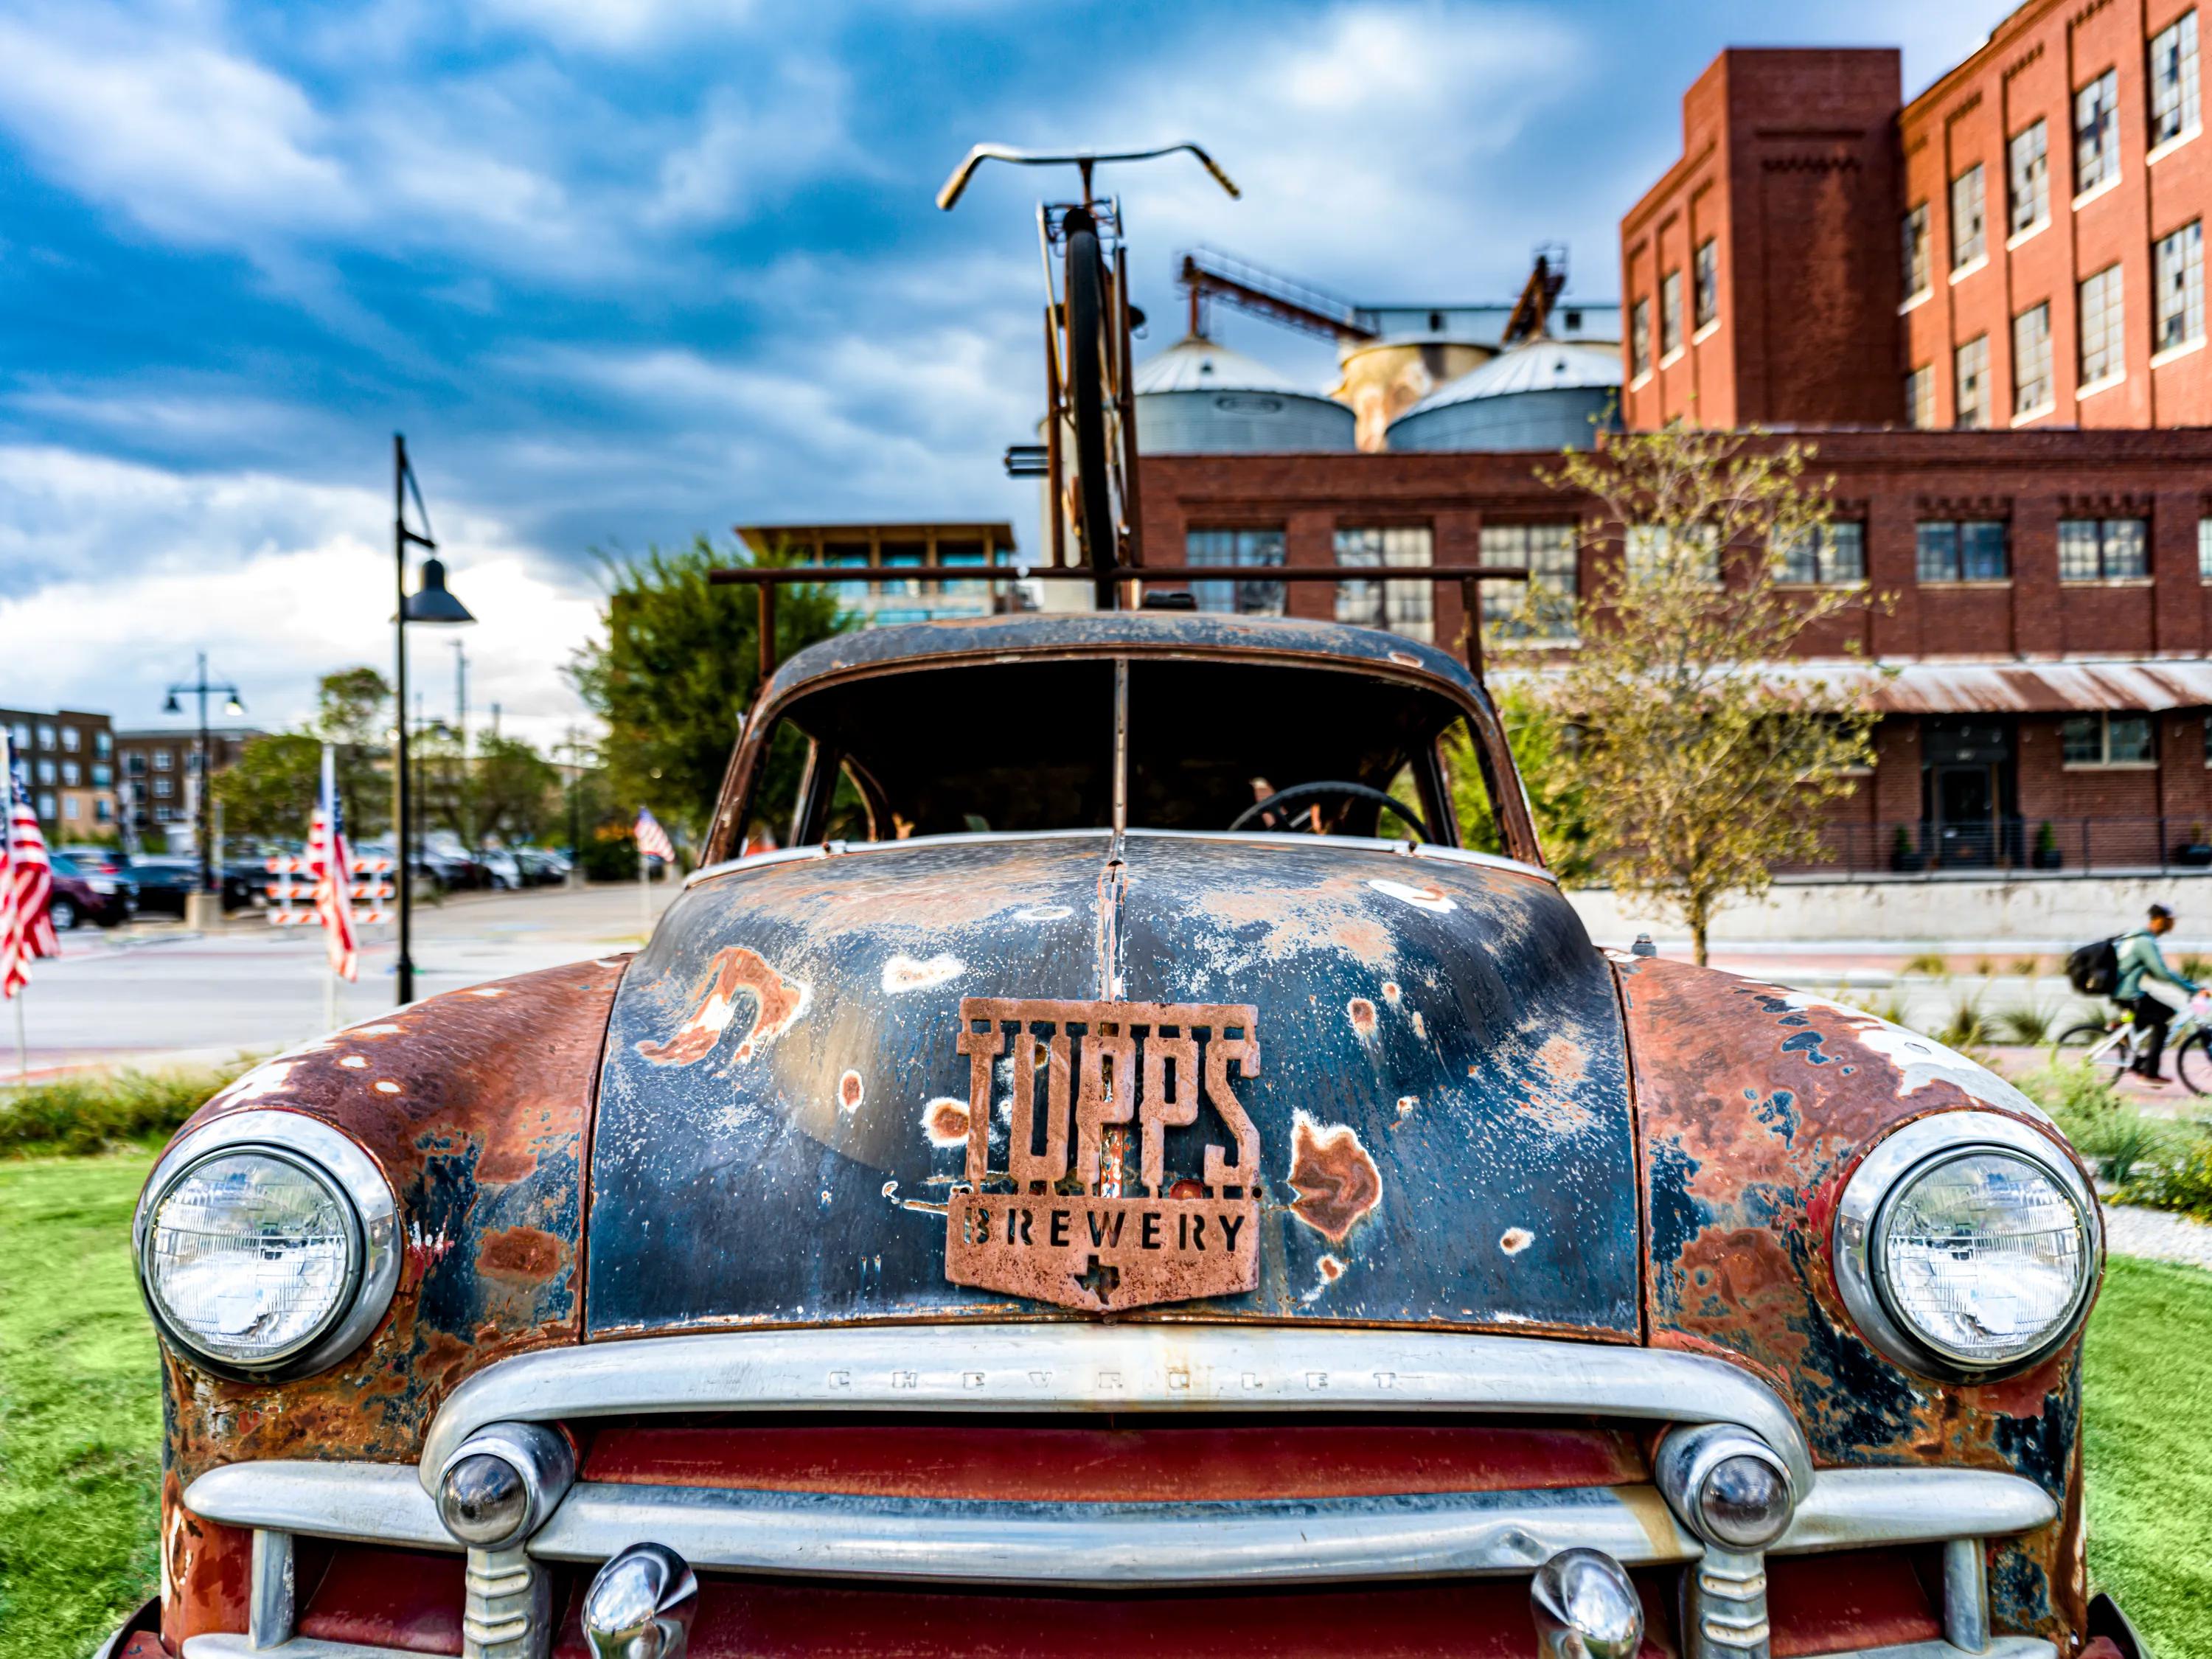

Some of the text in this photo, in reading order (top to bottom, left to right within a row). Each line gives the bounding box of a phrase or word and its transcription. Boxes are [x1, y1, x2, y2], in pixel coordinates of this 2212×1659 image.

[956, 1032, 1261, 1186] TUPPS
[963, 1206, 1245, 1251] BREWERY
[829, 1371, 1396, 1390] CHEVROLET
